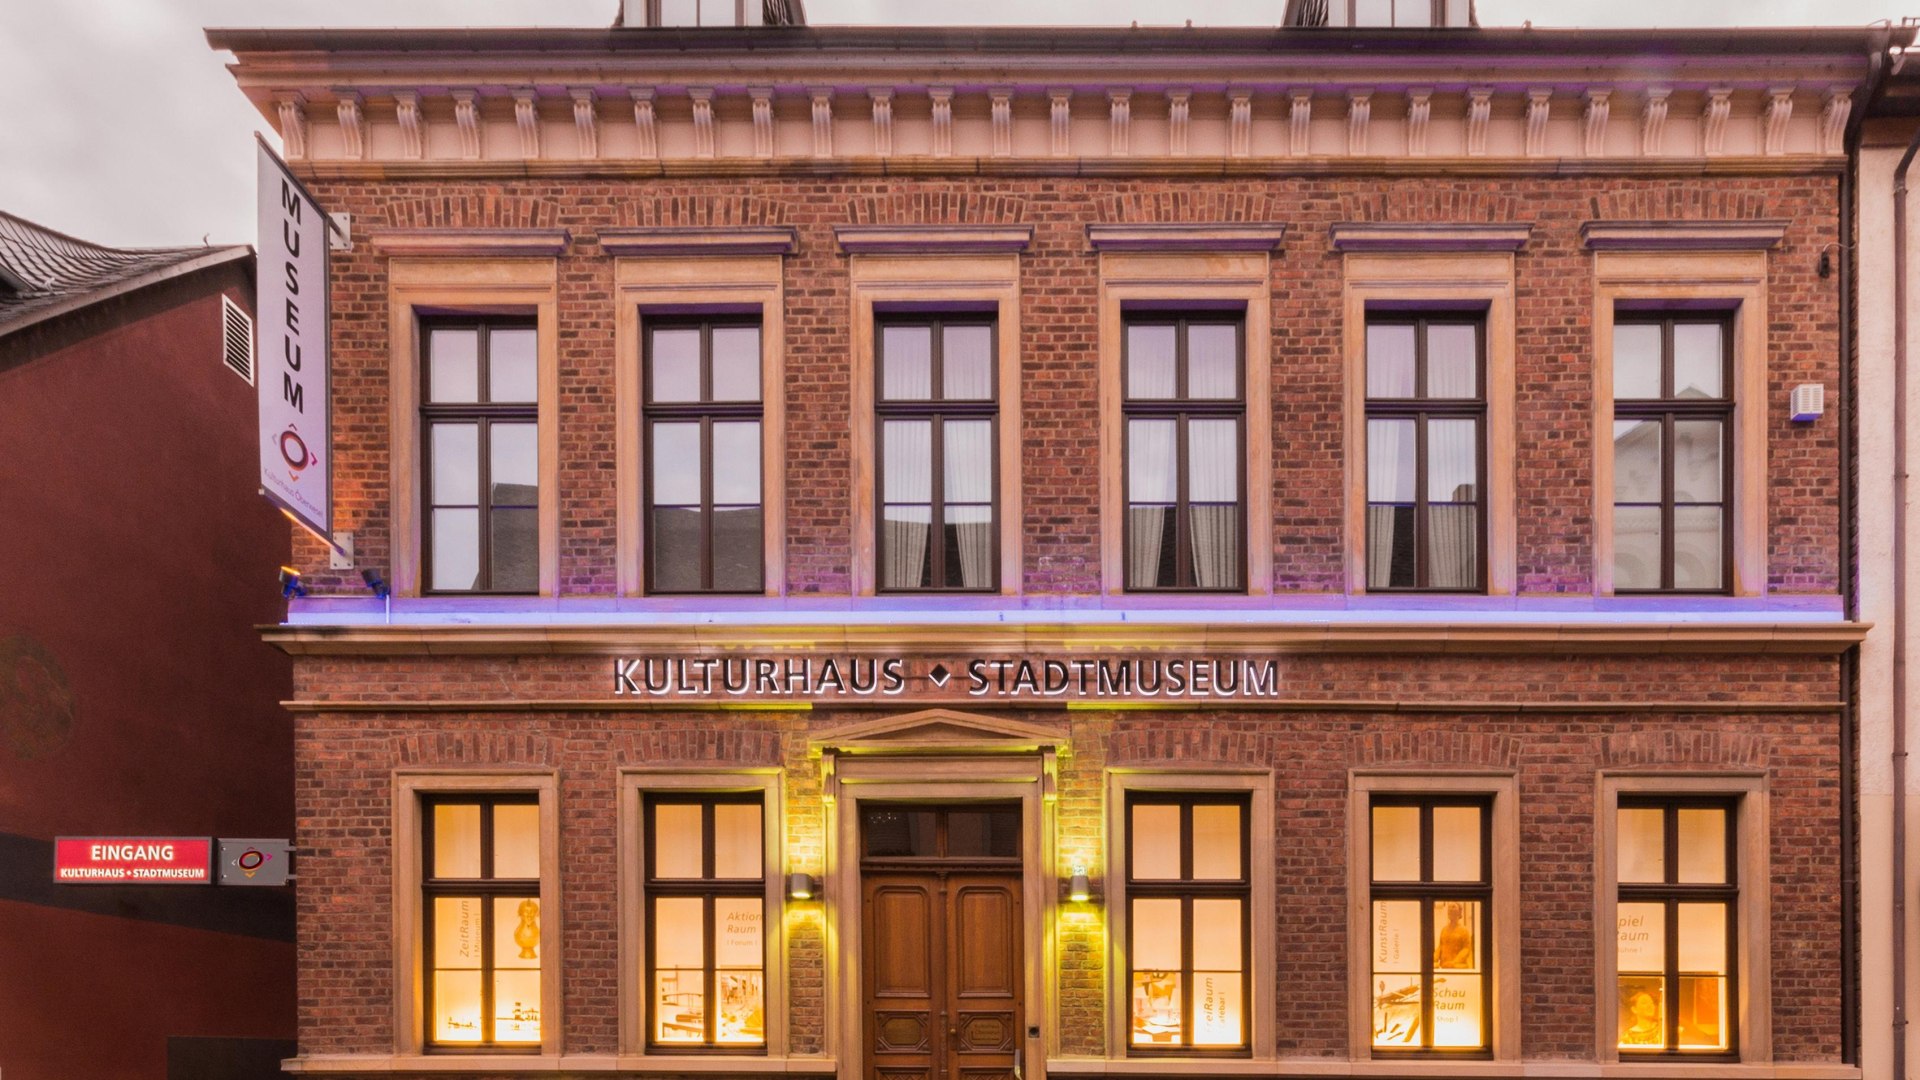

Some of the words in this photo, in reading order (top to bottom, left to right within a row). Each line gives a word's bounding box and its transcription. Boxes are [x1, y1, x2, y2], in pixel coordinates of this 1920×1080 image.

[281, 177, 304, 415] MUSEUM
[614, 658, 905, 695] KULTURHAUS
[968, 659, 1278, 696] STADTMUSEUM
[91, 845, 174, 861] EINGANG
[60, 868, 125, 878] KULTURHAUS
[133, 868, 205, 878] STADTMUSEUM
[459, 900, 469, 958] ZeitRaum
[727, 924, 757, 934] Raum
[1618, 914, 1644, 929] piel
[1617, 932, 1649, 941] aum
